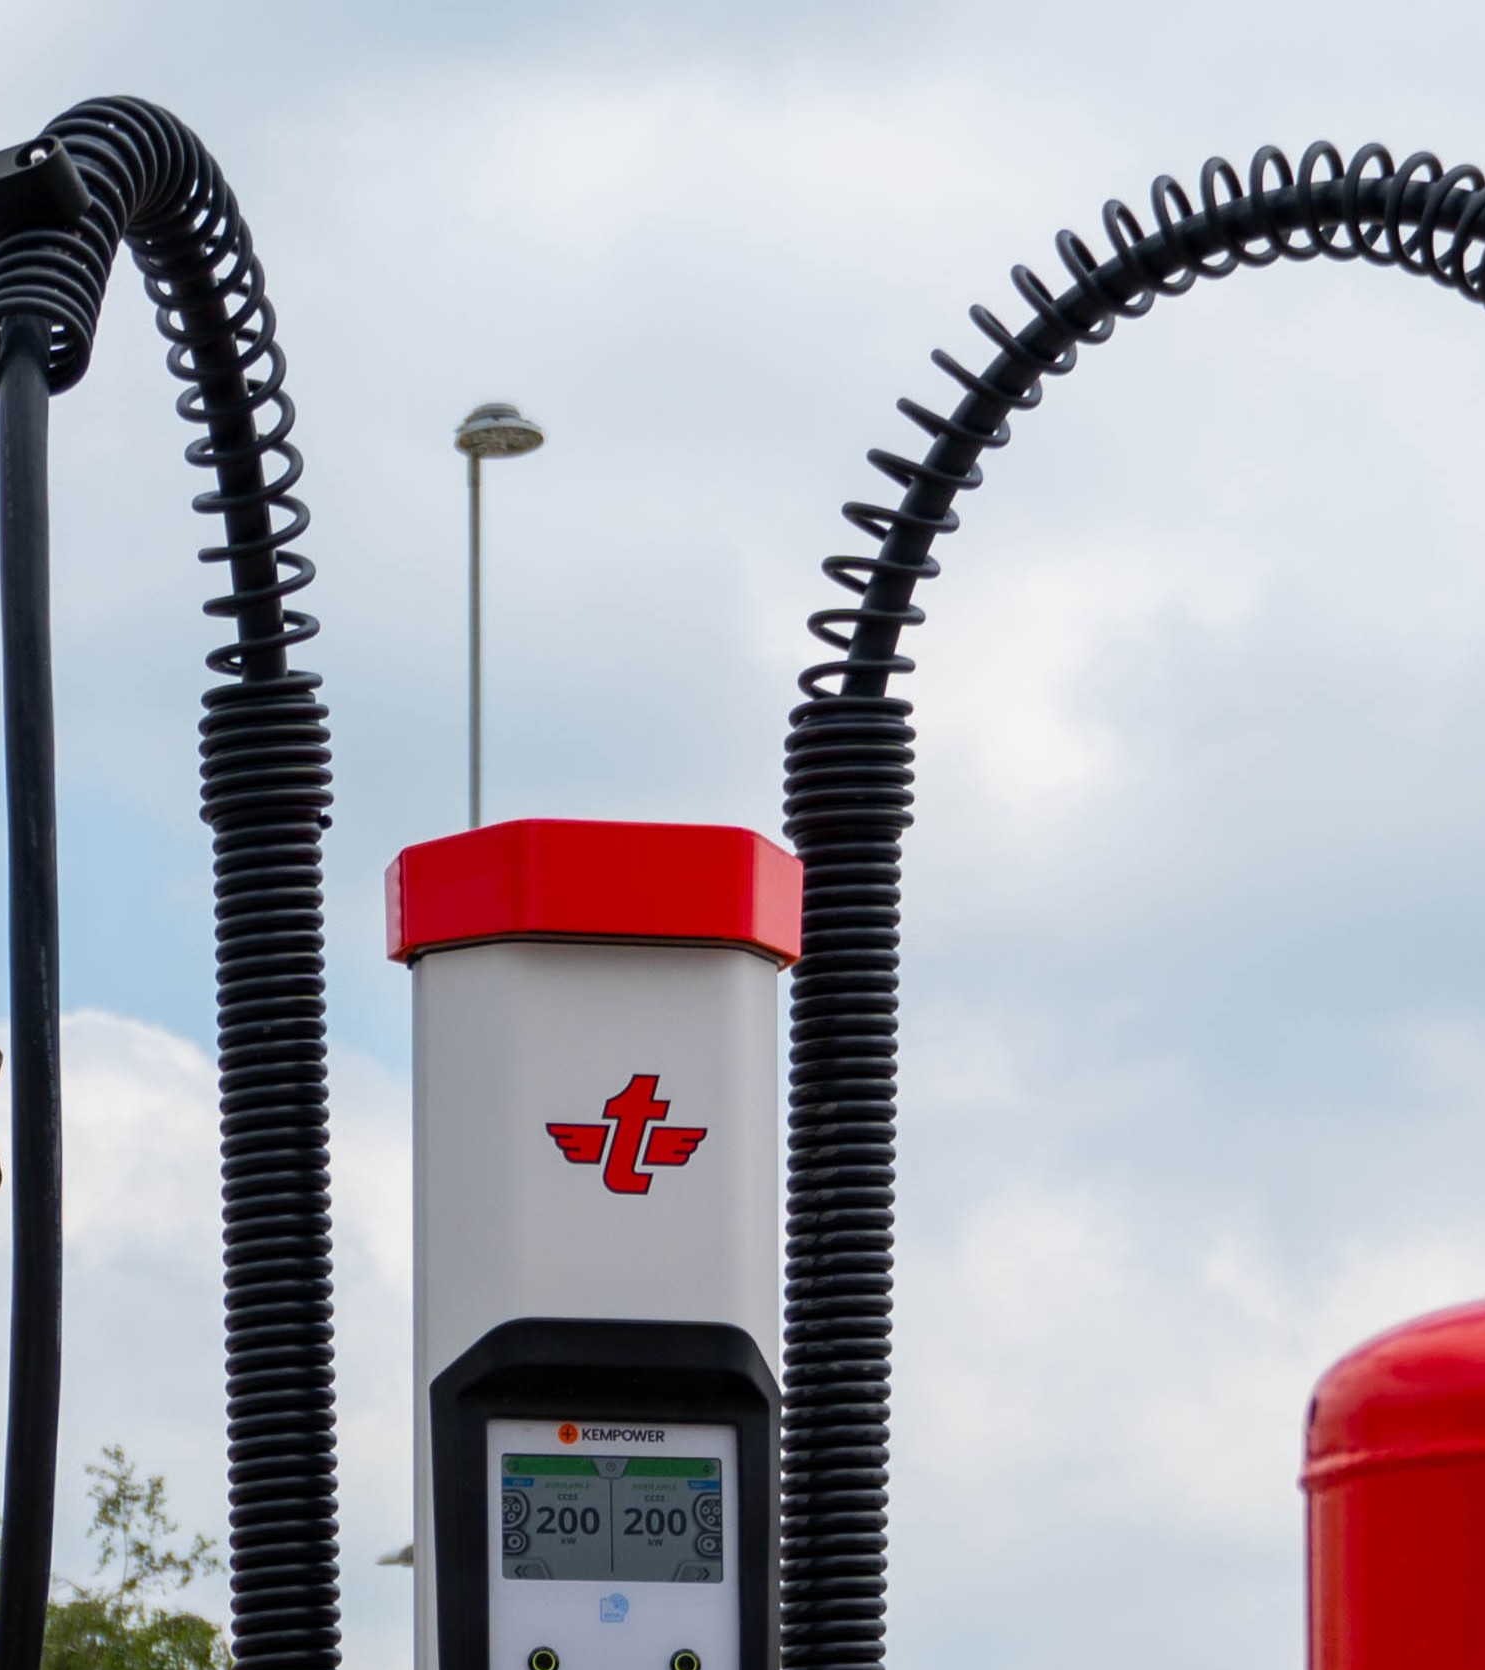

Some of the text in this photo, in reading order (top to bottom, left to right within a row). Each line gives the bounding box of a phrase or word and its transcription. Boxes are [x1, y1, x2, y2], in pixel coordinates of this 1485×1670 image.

[582, 1428, 665, 1443] KEMPOWER
[536, 1506, 600, 1535] 200
[623, 1507, 687, 1536] 200
